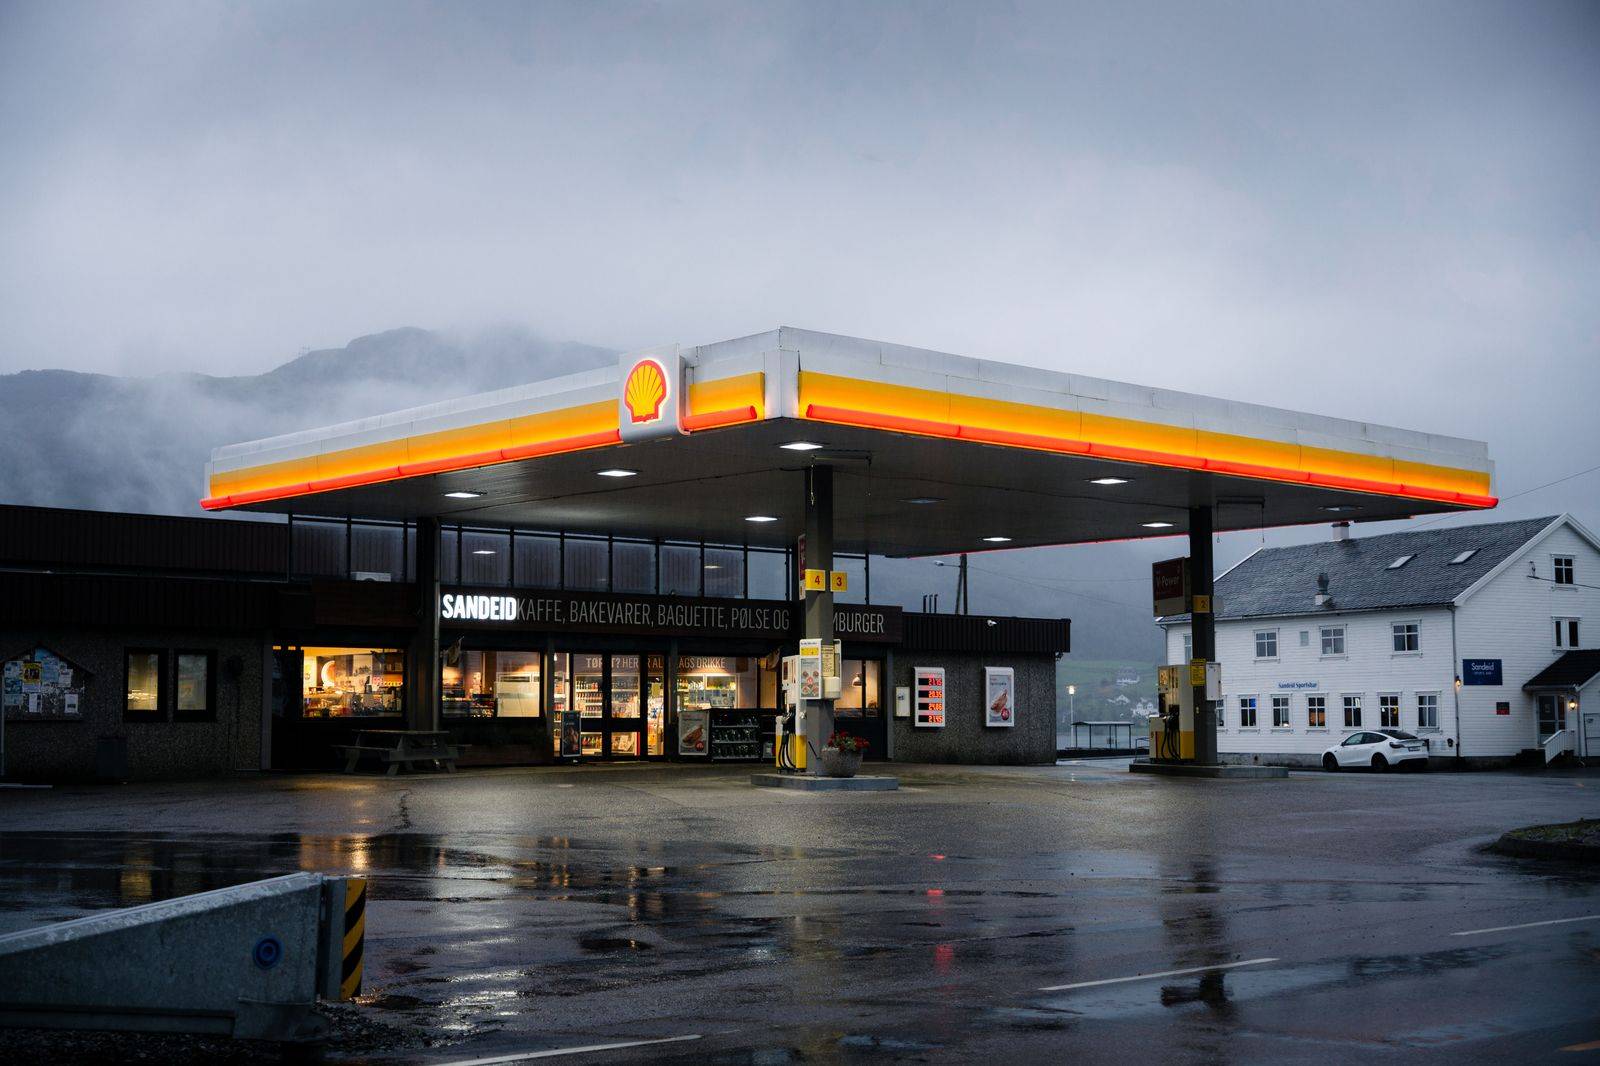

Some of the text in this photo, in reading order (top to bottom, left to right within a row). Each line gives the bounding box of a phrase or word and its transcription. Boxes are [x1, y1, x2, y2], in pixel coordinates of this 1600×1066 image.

[815, 575, 820, 585] 4
[836, 577, 842, 586] 3
[1200, 600, 1206, 608] 2
[442, 594, 517, 621] SANDEID
[517, 599, 565, 624] KAFFE,
[570, 600, 654, 628] BAKEVARER,
[658, 604, 728, 630] BAGUETTE,
[731, 607, 769, 630] PØLSE
[774, 609, 789, 630] OG
[586, 657, 620, 668] TØRT?
[622, 657, 638, 669] HER
[678, 657, 695, 669] AGS
[696, 657, 726, 669] DRIKKE
[1471, 662, 1494, 671] Sandeid
